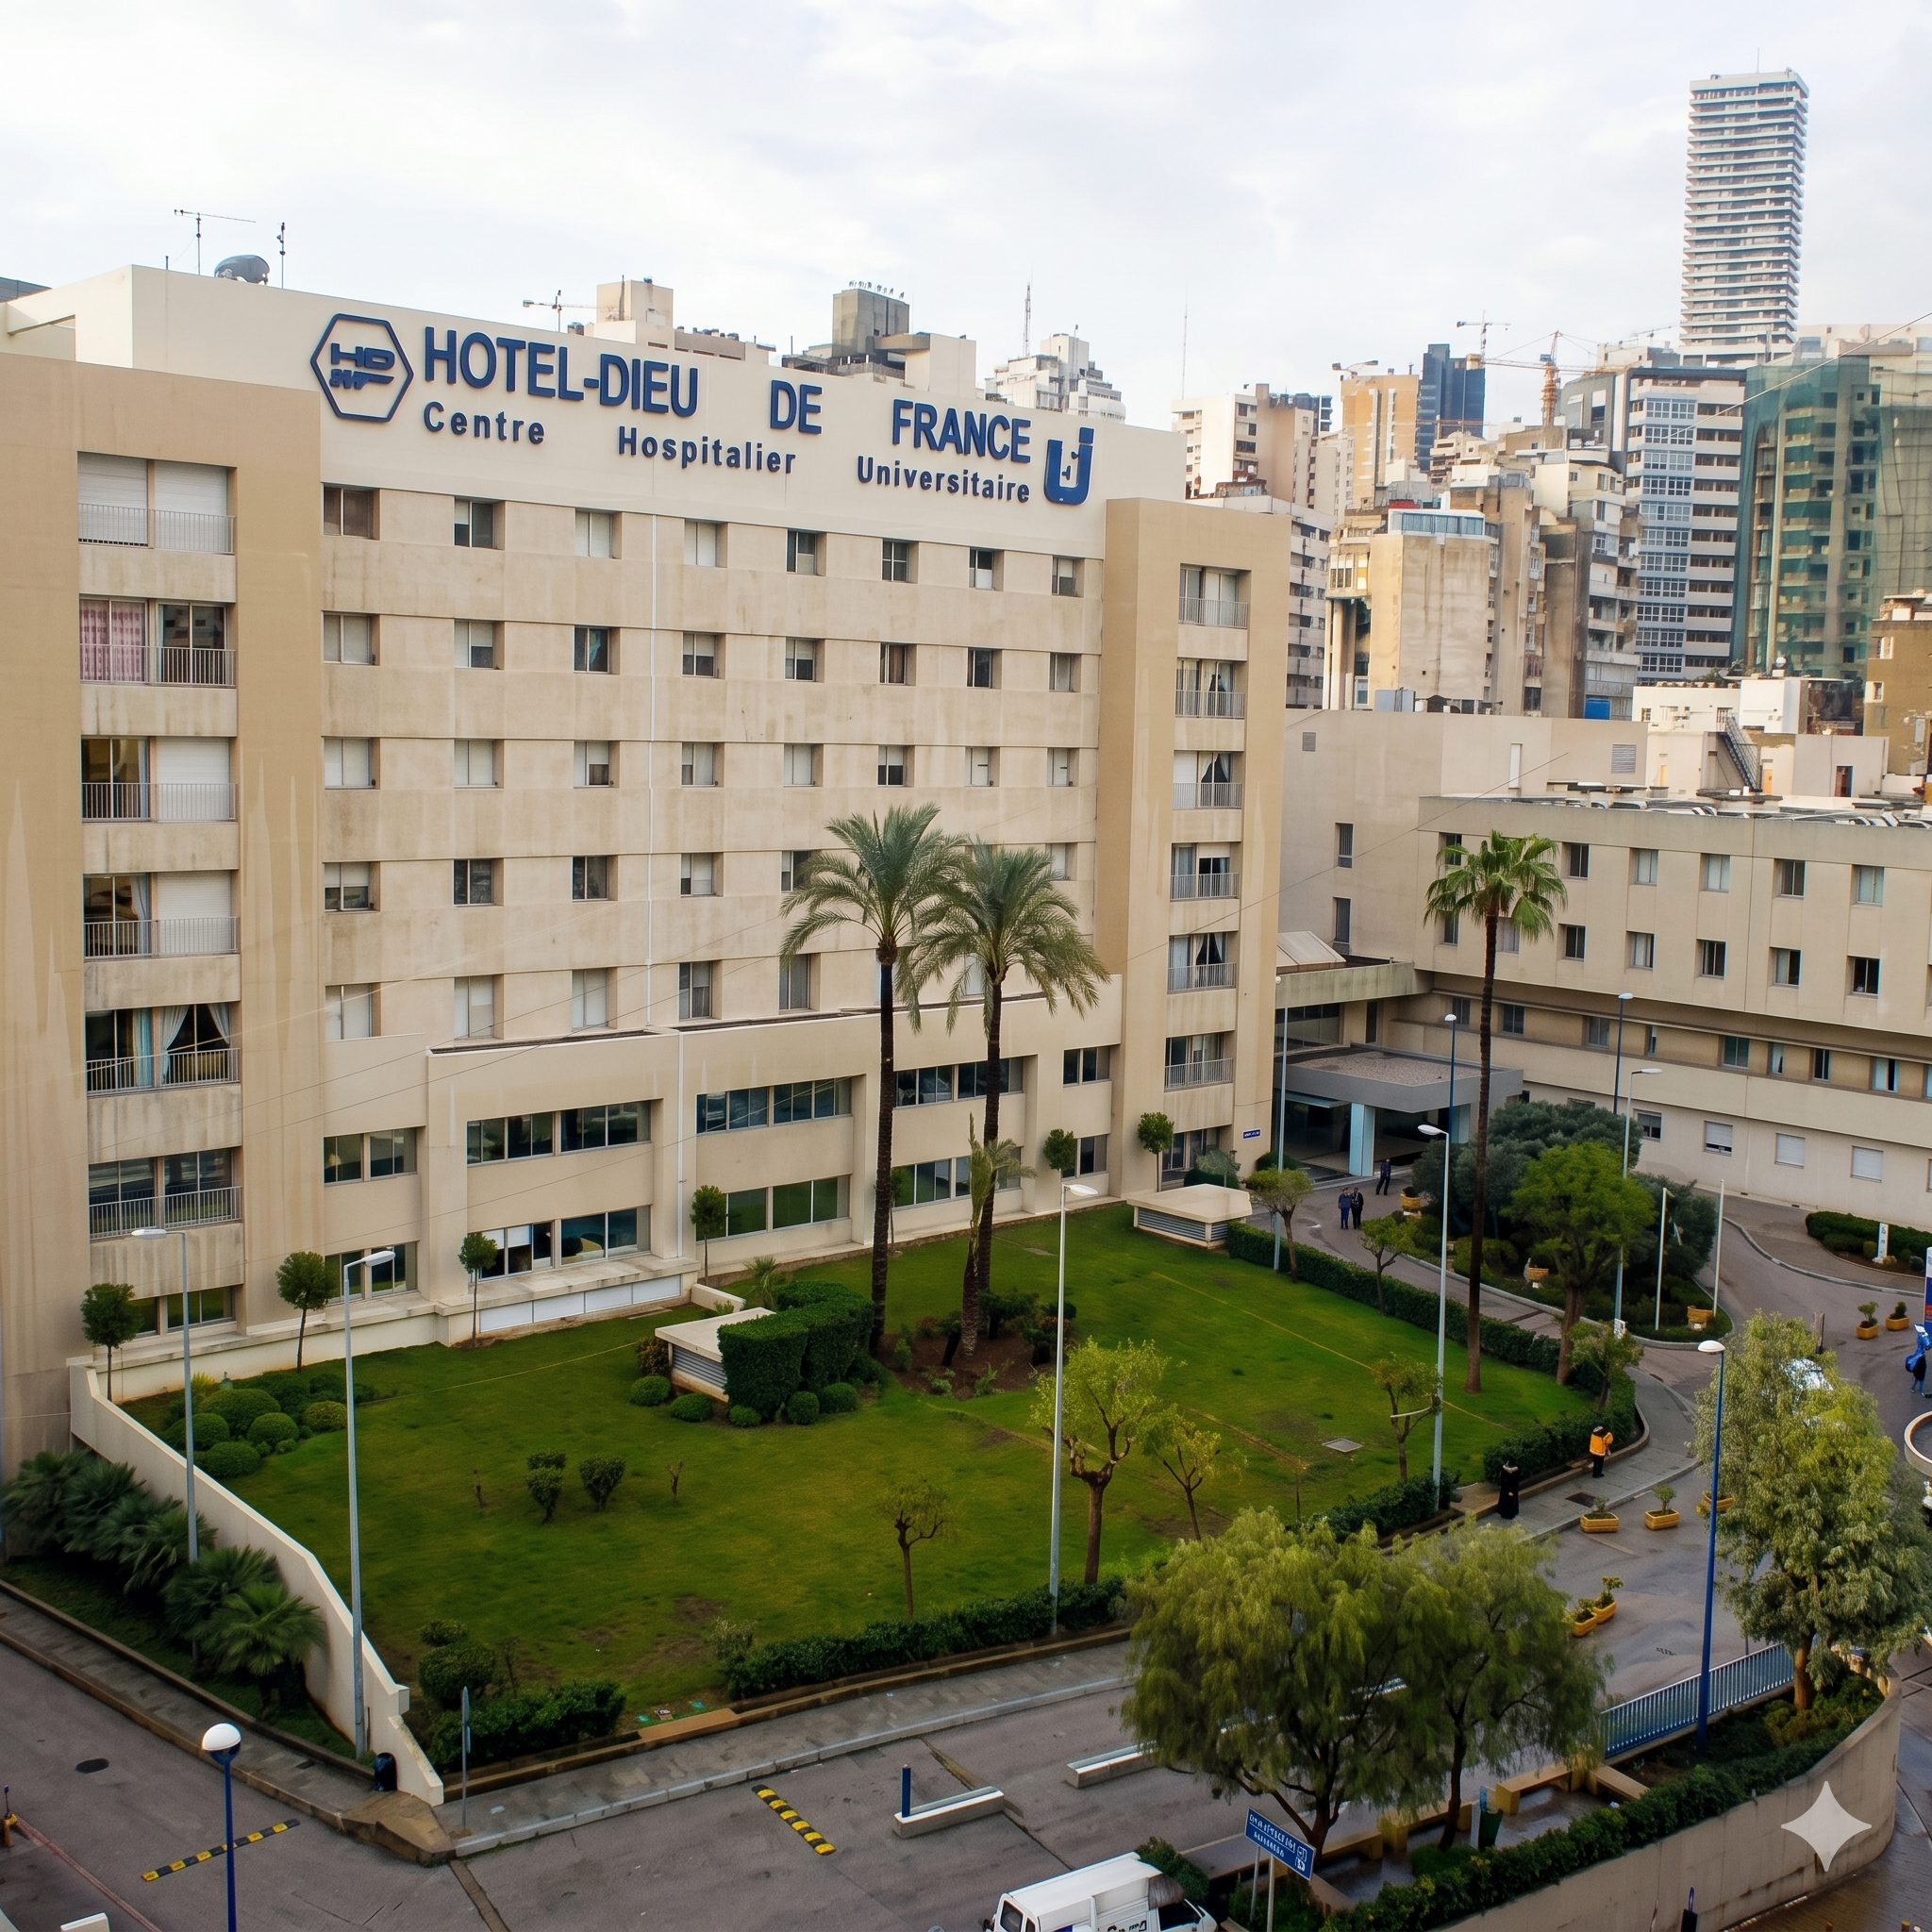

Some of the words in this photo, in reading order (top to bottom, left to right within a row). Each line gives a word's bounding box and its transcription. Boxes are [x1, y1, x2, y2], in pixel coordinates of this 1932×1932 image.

[423, 401, 545, 444] Centre
[618, 425, 796, 474] Hospitalier
[858, 456, 1030, 503] Universitaire
[425, 326, 698, 417] HOTEL-DIEU
[770, 379, 823, 434] DE
[892, 399, 1031, 463] FRANCE
